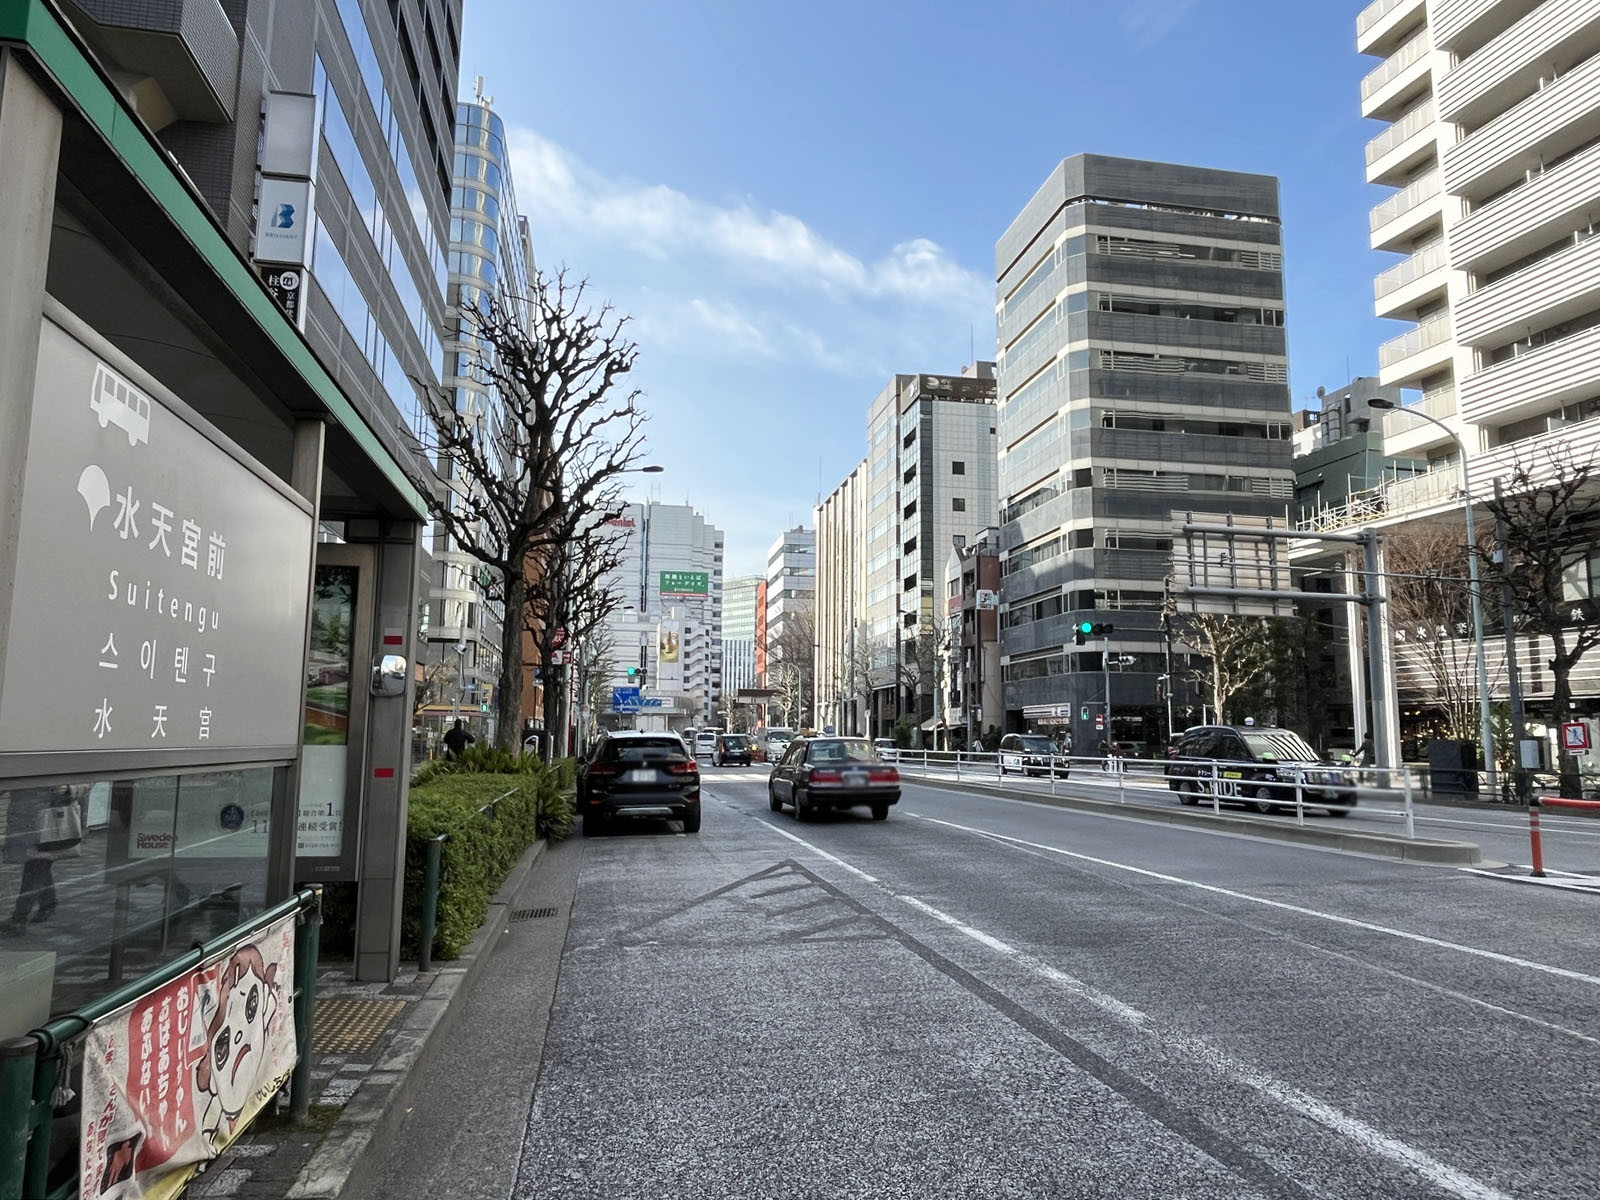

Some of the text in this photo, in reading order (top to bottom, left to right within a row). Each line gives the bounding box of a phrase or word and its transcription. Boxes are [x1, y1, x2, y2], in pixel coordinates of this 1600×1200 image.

[113, 486, 226, 580] 水天宮前
[108, 569, 220, 632] Suitengu
[98, 631, 216, 687] 스이텐구
